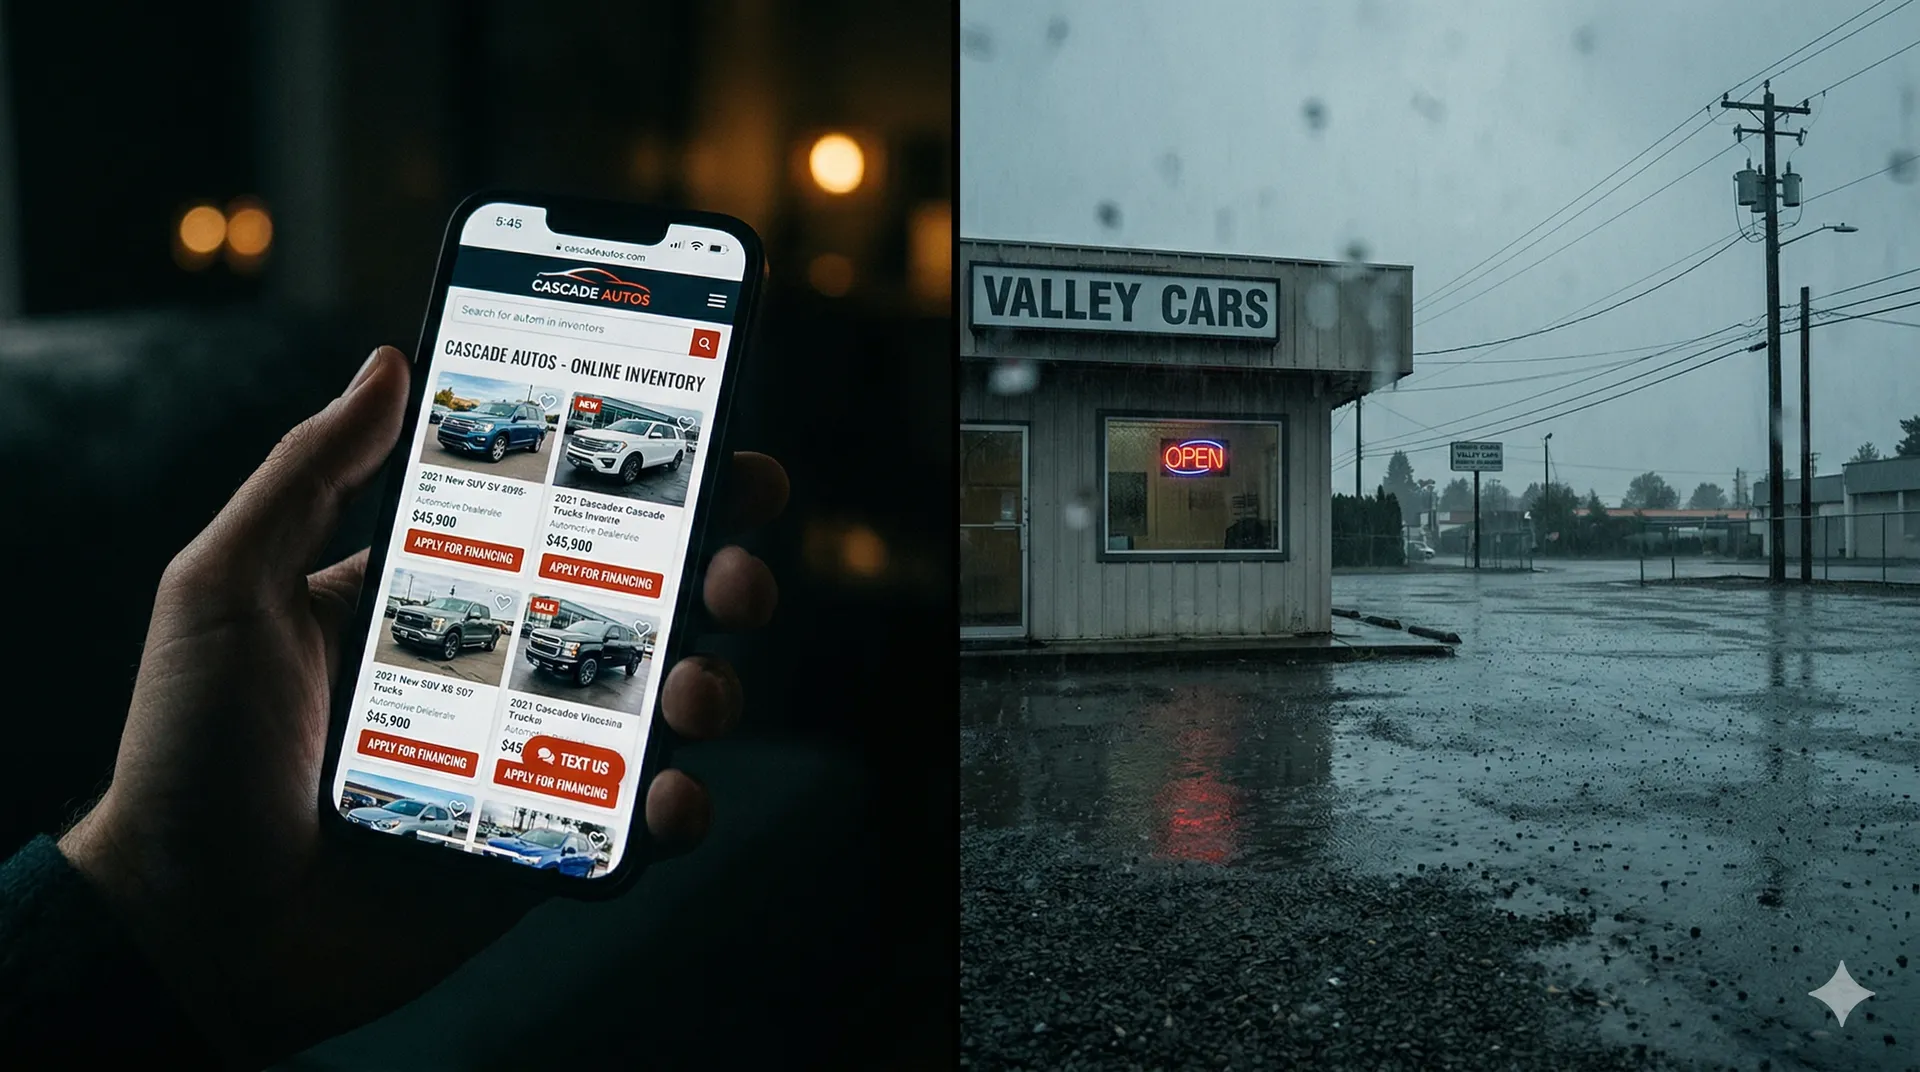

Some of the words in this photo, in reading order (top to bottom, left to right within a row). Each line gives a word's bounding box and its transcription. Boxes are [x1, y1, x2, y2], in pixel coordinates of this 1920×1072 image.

[496, 216, 522, 229] 5:45
[531, 279, 599, 300] CASCADE
[601, 288, 650, 306] AUTOS
[982, 275, 1142, 323] VALLEY
[1161, 284, 1268, 329] CARS
[462, 305, 495, 318] Search
[498, 310, 511, 320] for
[547, 317, 556, 326] in
[445, 339, 508, 363] CASCADE
[510, 349, 558, 370] AUTOS
[571, 358, 621, 380] ONLINE
[624, 366, 706, 393] INVENTORY
[1166, 446, 1224, 468] OPEN
[421, 471, 443, 482] 2021
[445, 475, 465, 486] New
[466, 479, 486, 489] SUV
[553, 506, 583, 519] Trucks
[555, 494, 577, 505] 2021
[626, 506, 666, 521] Cascade
[412, 509, 457, 528] $45,900
[414, 537, 444, 552] APPLY
[445, 542, 463, 556] FOR
[464, 546, 514, 565] FINANCING
[546, 534, 593, 553] $45,900
[548, 561, 580, 577] APPLY
[581, 567, 600, 581] FOR
[601, 570, 653, 590] FINANCING
[534, 601, 555, 612] SALE
[375, 670, 397, 681] 2021
[399, 675, 420, 686] New
[373, 682, 403, 696] Trucks
[510, 698, 533, 710] 2021
[366, 709, 411, 729] $45,900
[367, 738, 397, 755] APPLY
[398, 745, 417, 758] FOR
[418, 748, 468, 769] FINANCING
[560, 753, 591, 772] TEXT
[592, 760, 610, 775] US
[504, 768, 535, 785] APPLY
[536, 774, 555, 789] FOR
[556, 778, 608, 800] FINANCING
